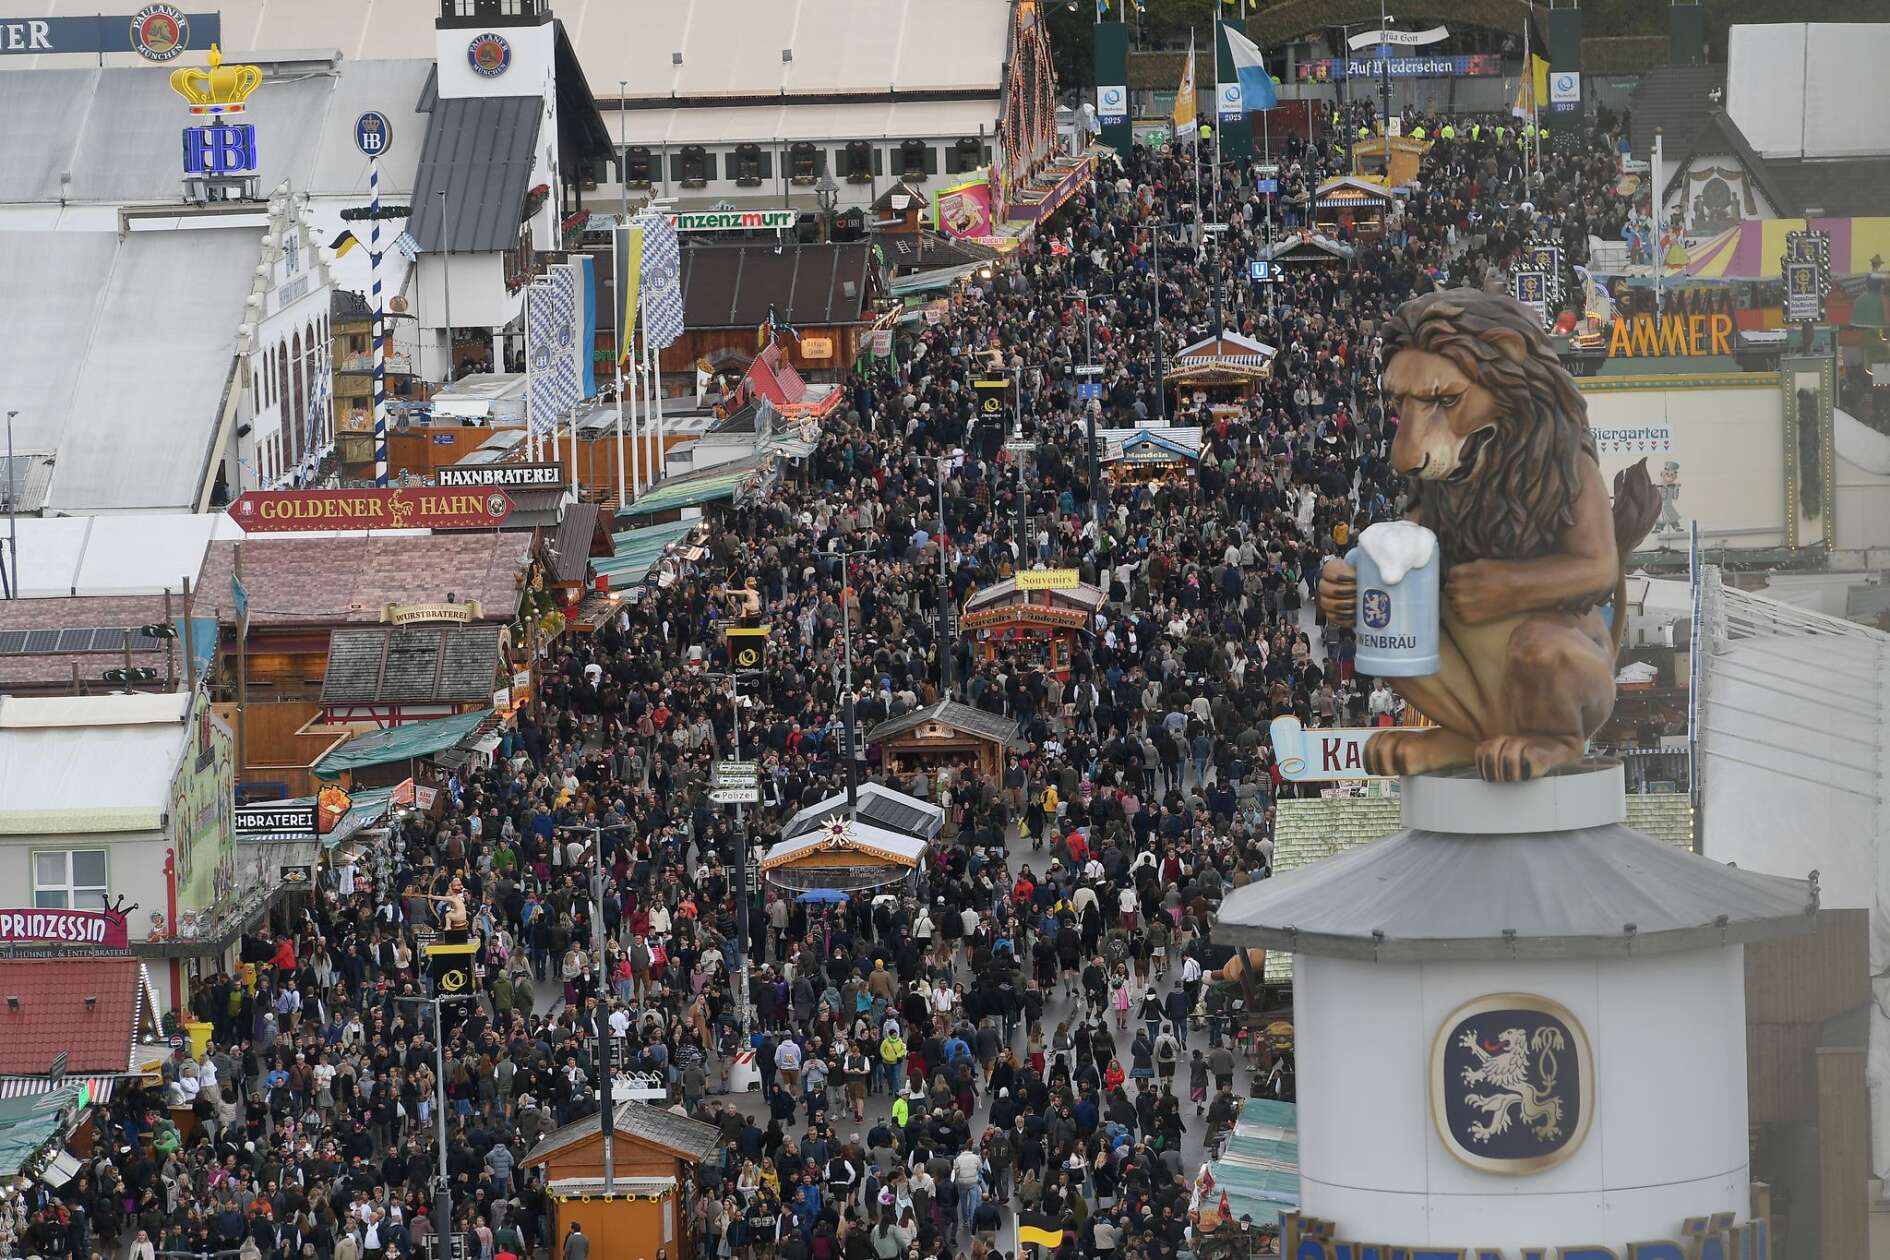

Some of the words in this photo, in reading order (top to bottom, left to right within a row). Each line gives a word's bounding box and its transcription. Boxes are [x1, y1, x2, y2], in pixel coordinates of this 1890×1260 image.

[133, 5, 186, 29] PAULANER
[0, 20, 53, 49] ER
[468, 34, 509, 53] PAULANER
[1347, 61, 1371, 77] Auf
[1104, 116, 1122, 125] 2025
[1225, 113, 1242, 122] 2025
[186, 124, 257, 173] HB
[362, 132, 381, 150] HB
[1608, 313, 1733, 358] AMMER
[1590, 427, 1669, 442] Biergarten
[1126, 451, 1169, 459] Mandeln
[440, 467, 559, 486] HAXNBRATEREI
[260, 498, 384, 519] GOLDENER
[419, 495, 484, 514] HAHN
[1022, 575, 1072, 585] Souvenirs
[396, 612, 468, 622] WURSTBRATEREI
[964, 615, 1011, 628] Souvenirs
[1322, 738, 1361, 772] KA
[722, 791, 754, 800] Polizei
[67, 948, 132, 957] ENTENBRATEREI
